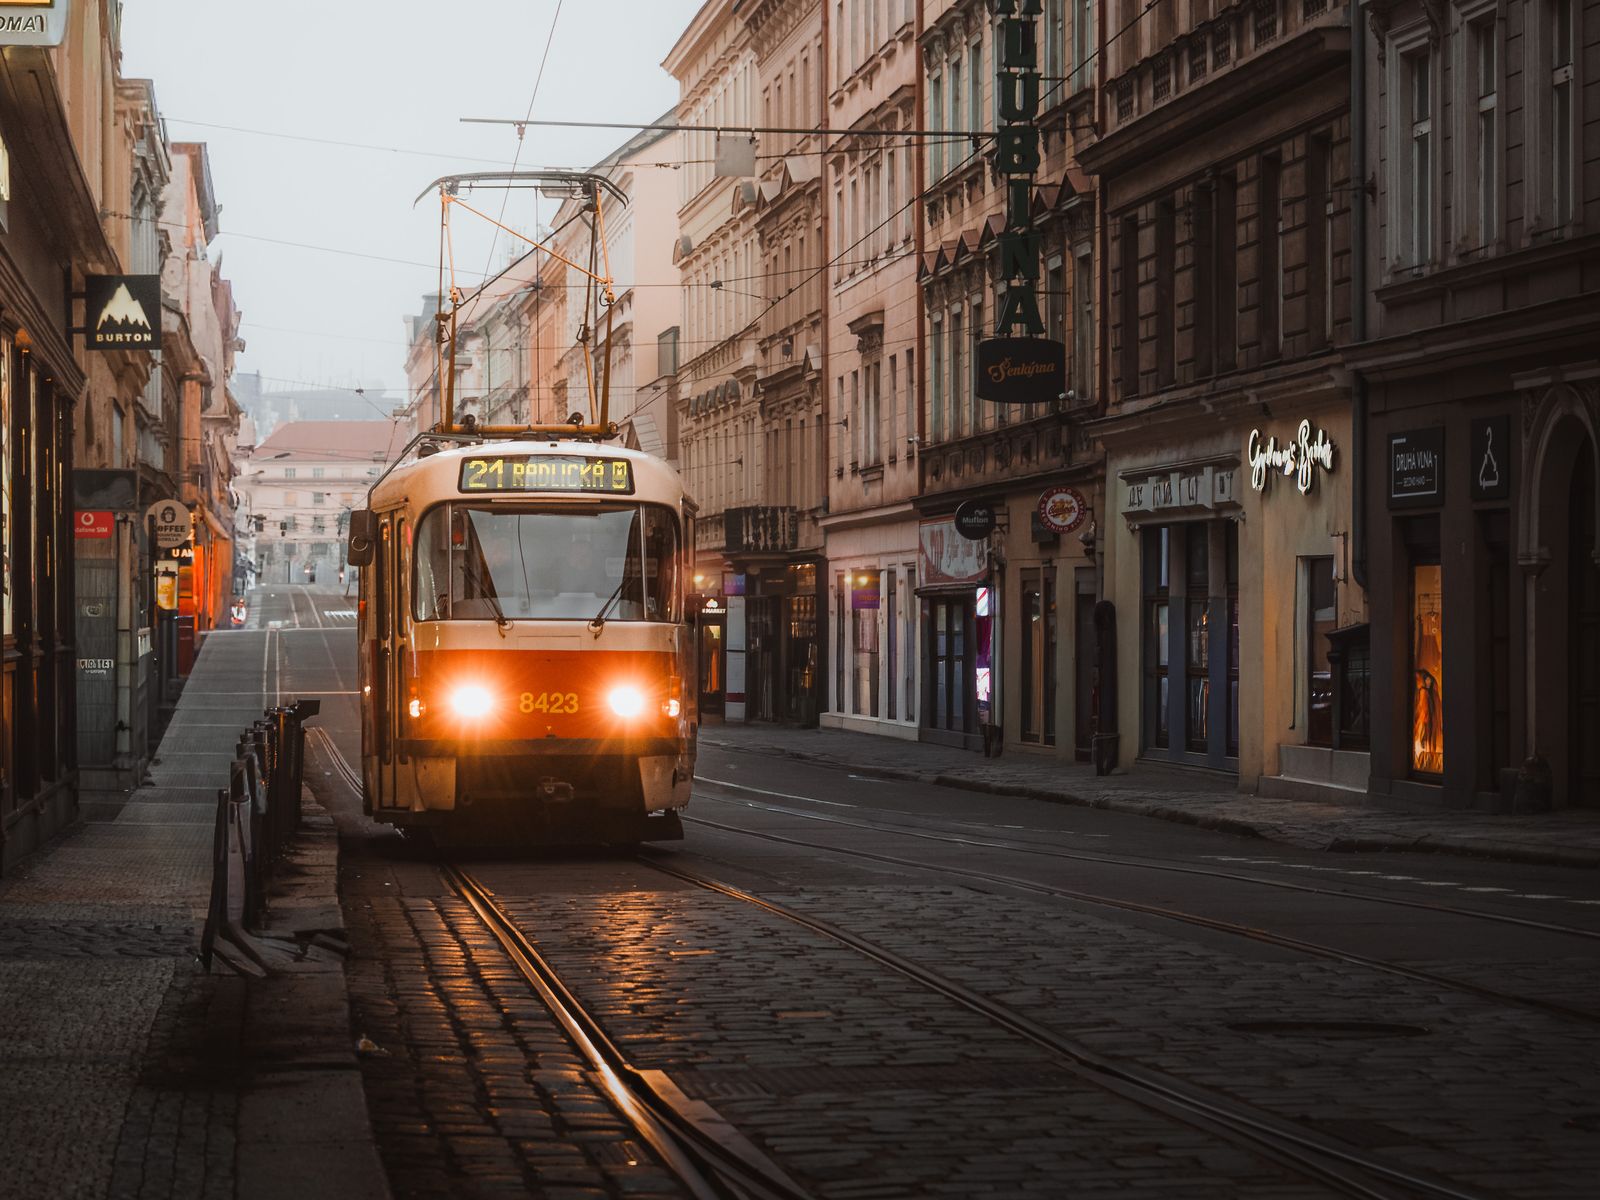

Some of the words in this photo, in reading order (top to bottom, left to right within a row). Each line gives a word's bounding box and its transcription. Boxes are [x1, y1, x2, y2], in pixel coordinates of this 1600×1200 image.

[995, 0, 1046, 334] LUBINA
[96, 333, 152, 342] BURTON
[1396, 447, 1416, 472] DRUHÁ
[1416, 450, 1433, 469] VLNA
[468, 460, 504, 487] 21
[512, 460, 604, 487] RADLICKÁ
[962, 516, 989, 524] Muflon
[519, 692, 579, 714] 8423
